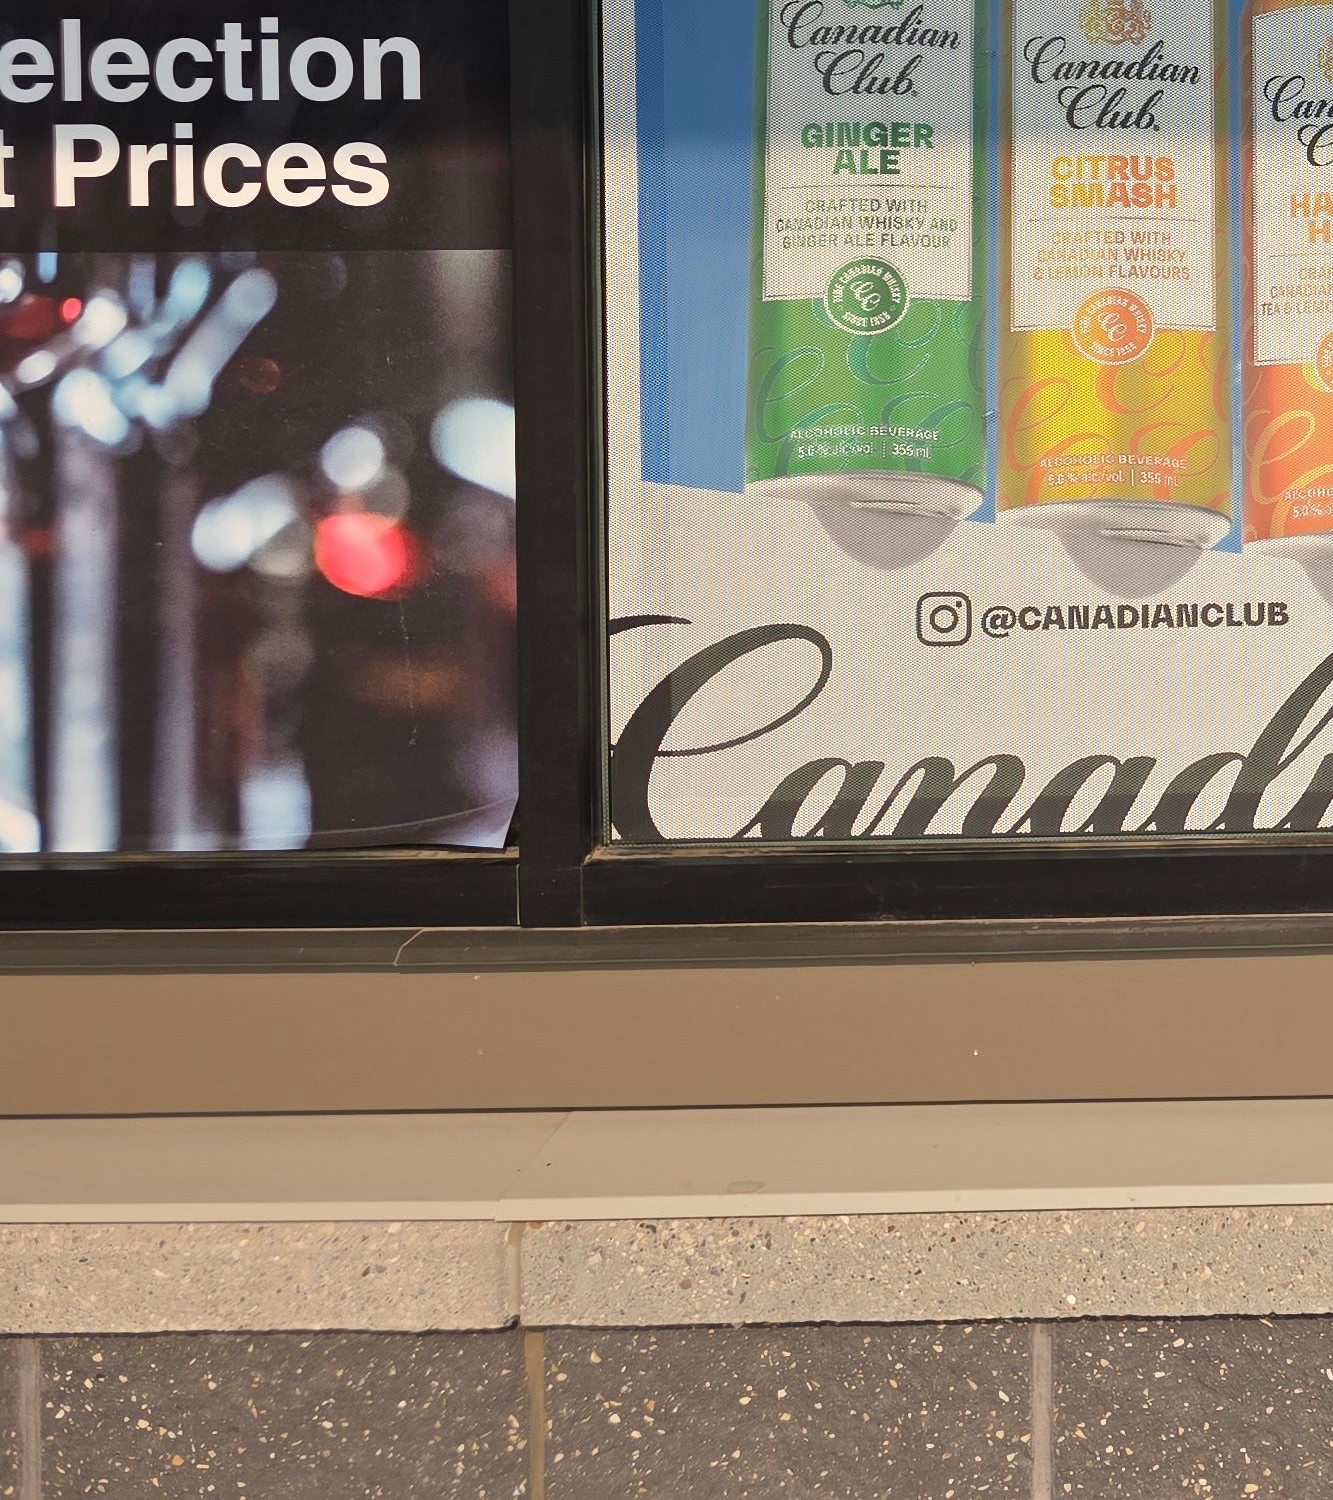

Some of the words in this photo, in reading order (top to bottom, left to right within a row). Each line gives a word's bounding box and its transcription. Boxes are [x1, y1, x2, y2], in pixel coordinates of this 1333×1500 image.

[779, 0, 960, 49] Canadian
[1023, 36, 1200, 84] Canadian
[799, 121, 935, 149] GINGER
[53, 121, 390, 208] Prices
[833, 149, 901, 176] ALE
[1052, 155, 1176, 181] CITRUS
[805, 198, 881, 213] CRAFTED
[886, 198, 928, 213] WITH
[1049, 183, 1177, 209] SMASH
[776, 216, 854, 233] CANADIAN
[858, 216, 924, 231] WHISKY
[782, 234, 838, 250] GINGER
[843, 233, 875, 248] ALE
[880, 233, 951, 249] FLAVOUR
[1051, 230, 1125, 245] CRAFTED
[1130, 230, 1172, 245] WITH
[1123, 247, 1187, 262] WHISKY
[1108, 264, 1191, 281] FLAVOURS
[869, 426, 940, 442] BEVERAGE
[1118, 454, 1188, 470] BEVERAGE
[981, 600, 1290, 640] @CANADIANCLUB
